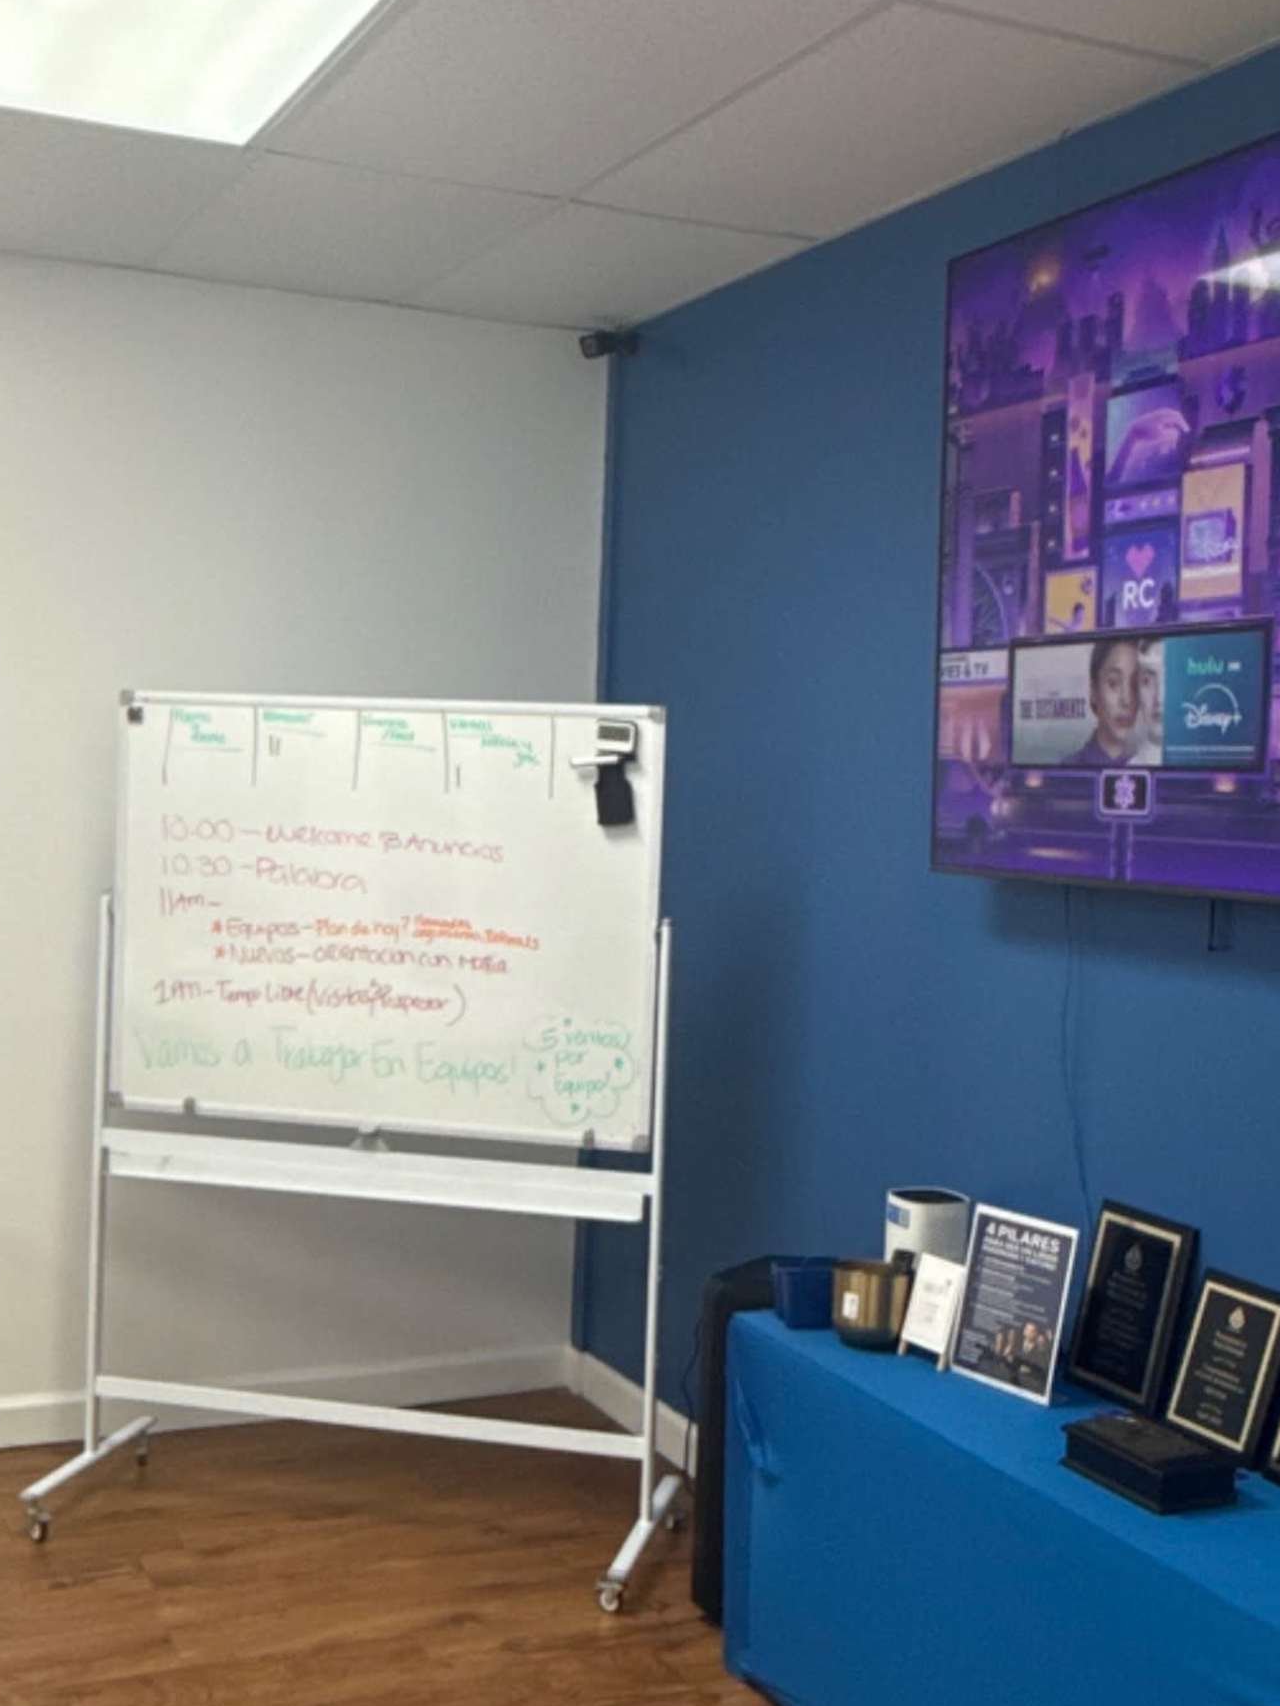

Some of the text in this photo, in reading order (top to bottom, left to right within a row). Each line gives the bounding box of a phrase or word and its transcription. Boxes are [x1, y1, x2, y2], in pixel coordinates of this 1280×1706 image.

[1122, 579, 1156, 610] RC
[255, 855, 369, 894] Palabra
[997, 1224, 1060, 1254] PILARES
